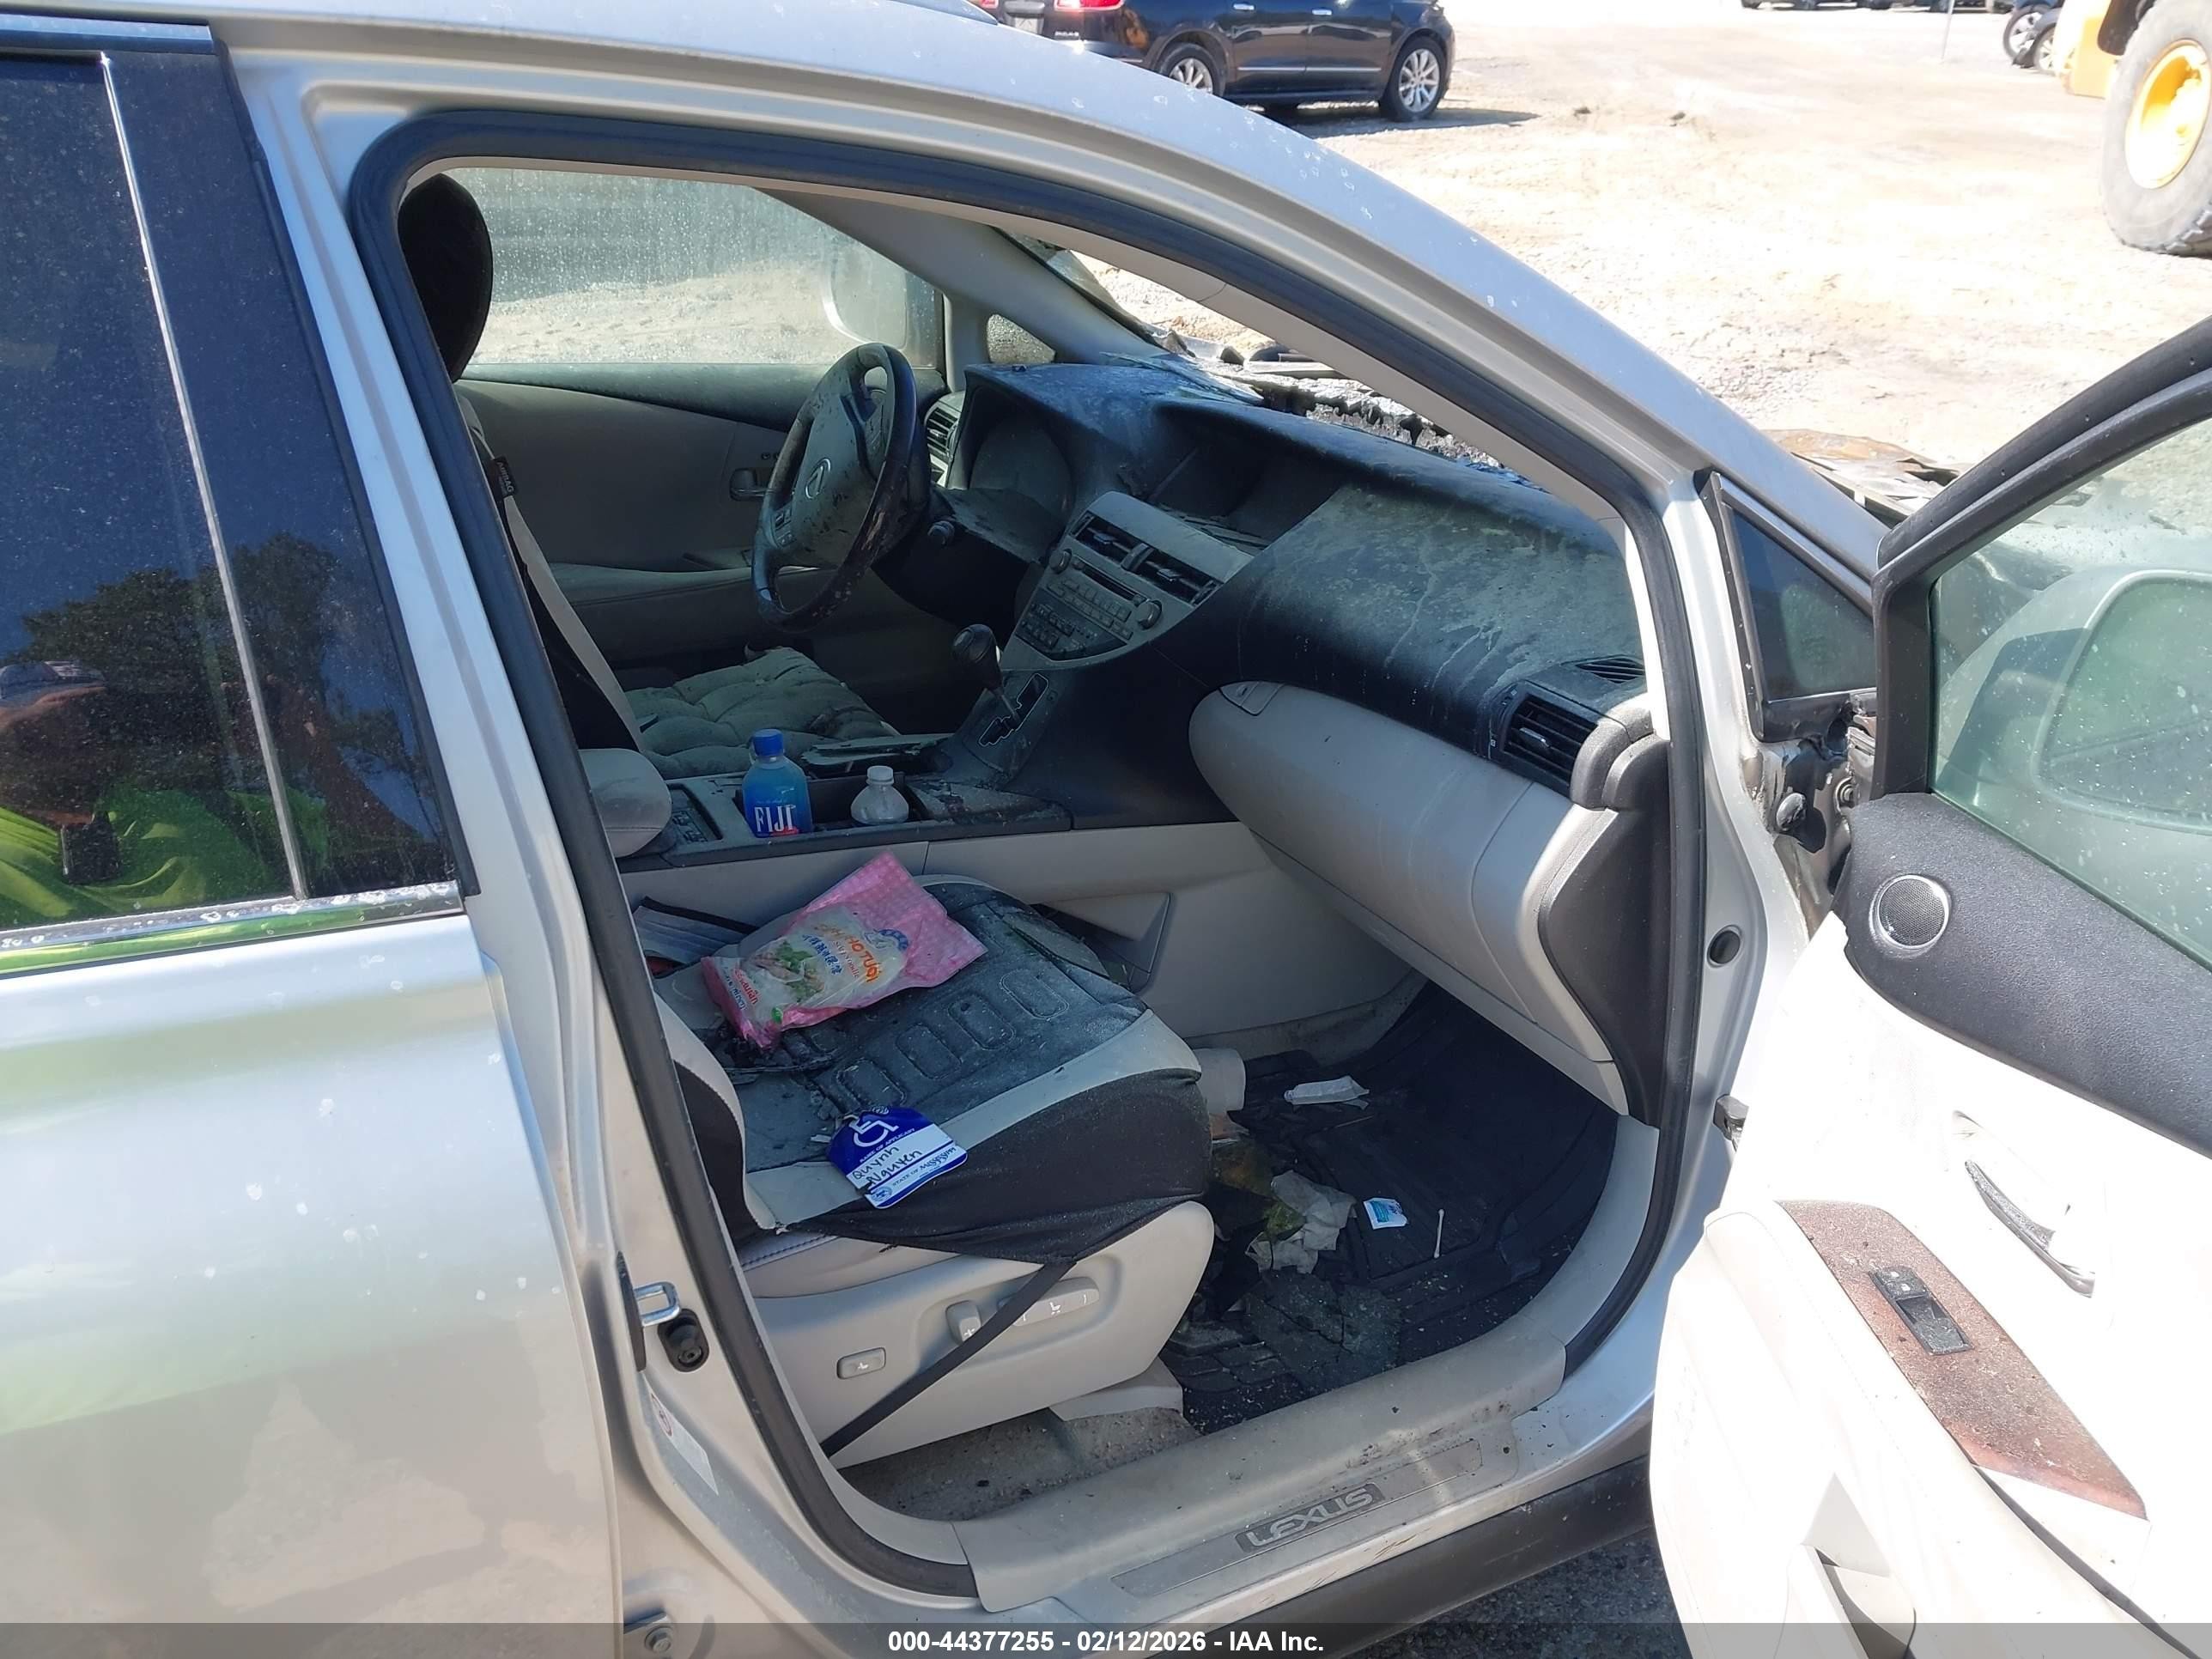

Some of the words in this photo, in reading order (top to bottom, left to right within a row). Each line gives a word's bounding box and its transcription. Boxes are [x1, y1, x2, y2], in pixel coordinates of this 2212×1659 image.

[754, 804, 797, 832] FIJI
[852, 1146, 900, 1180] Quynh
[1246, 1487, 1374, 1547] LEXUS
